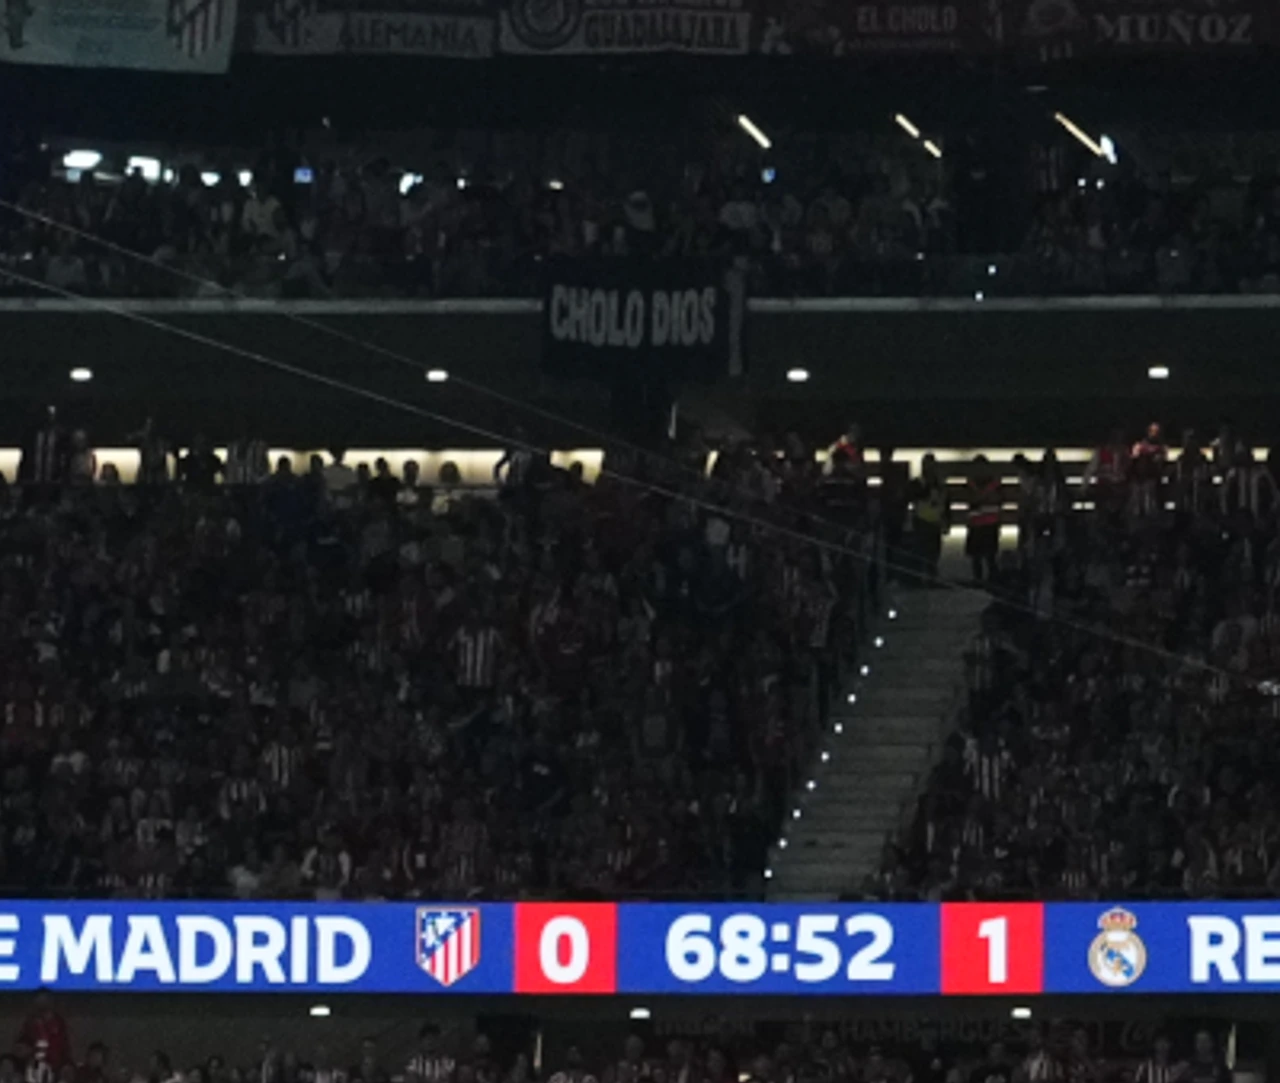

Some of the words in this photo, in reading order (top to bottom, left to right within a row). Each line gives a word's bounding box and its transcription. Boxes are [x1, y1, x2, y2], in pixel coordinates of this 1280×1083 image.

[857, 5, 882, 33] EL
[886, 5, 958, 33] CHOLO
[1093, 9, 1252, 45] MUÑOZ
[551, 284, 644, 347] CHOLO
[651, 286, 718, 346] DIOS
[41, 915, 371, 983] MADRID
[539, 916, 589, 984] 0
[666, 914, 895, 982] 68:52
[977, 917, 1008, 983] 1
